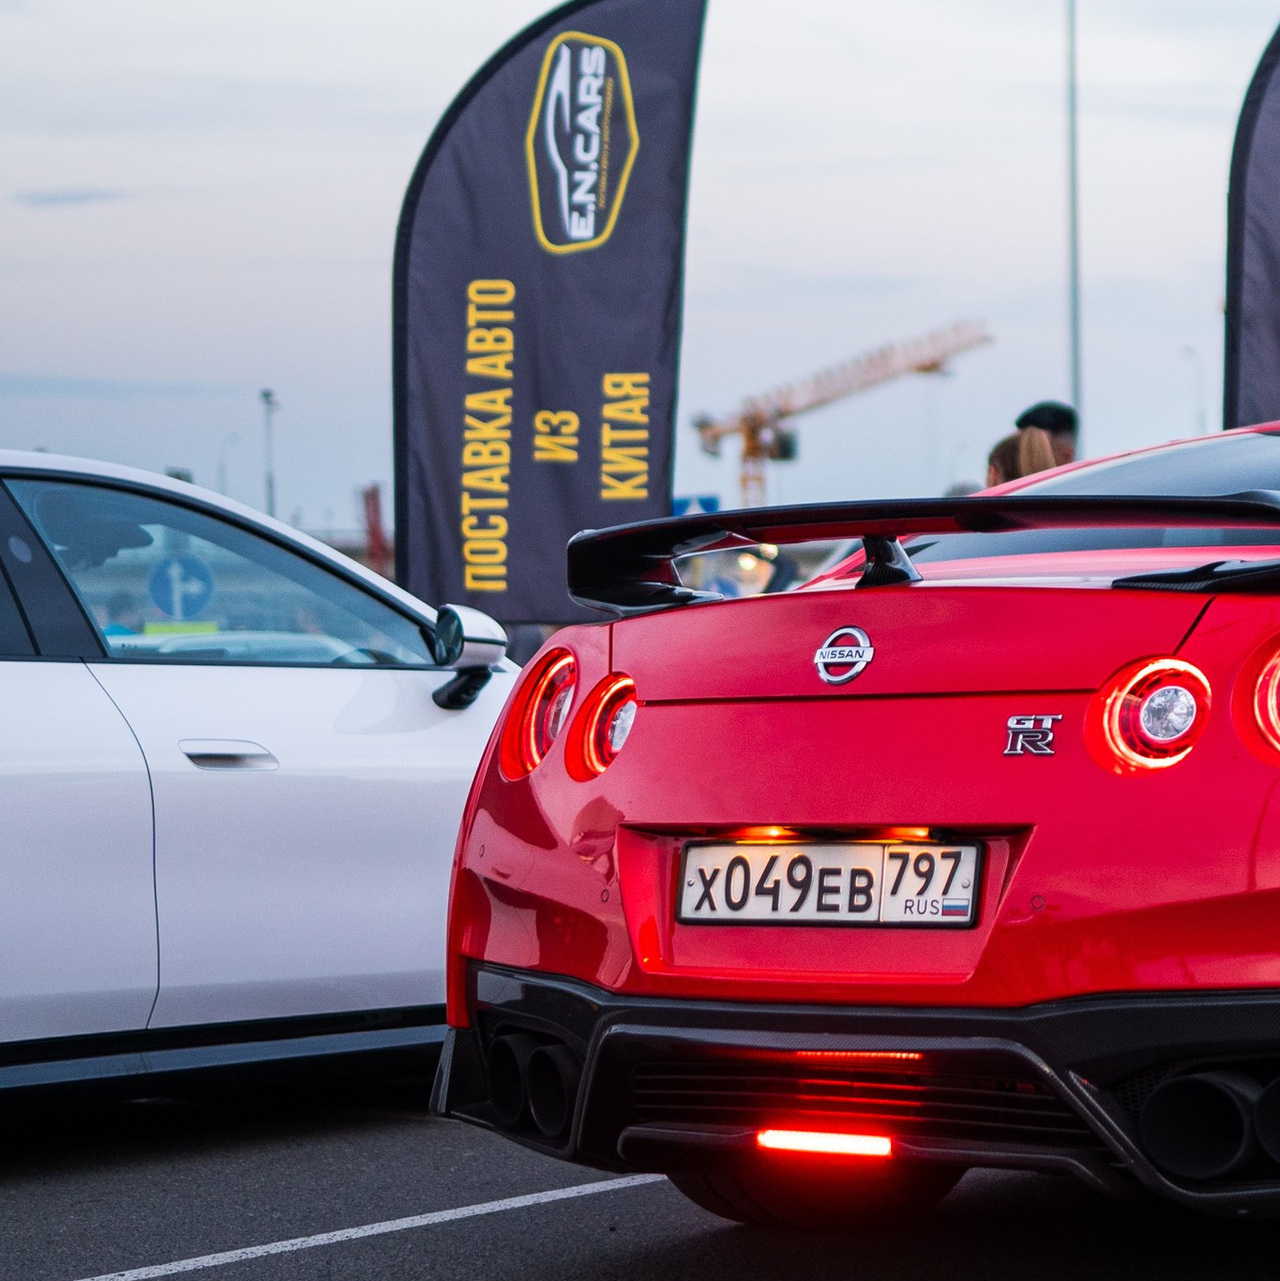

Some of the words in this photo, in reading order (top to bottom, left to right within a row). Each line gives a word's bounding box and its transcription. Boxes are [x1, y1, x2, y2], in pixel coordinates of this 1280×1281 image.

[570, 45, 607, 240] E.N.CARS
[466, 279, 516, 379] АВТО
[533, 410, 580, 462] ИЗ
[601, 372, 650, 500] КИТАЯ
[461, 388, 512, 591] ПОСТАВКА
[818, 648, 866, 660] NISSAN
[887, 851, 963, 896] 797
[904, 899, 940, 915] RUS
